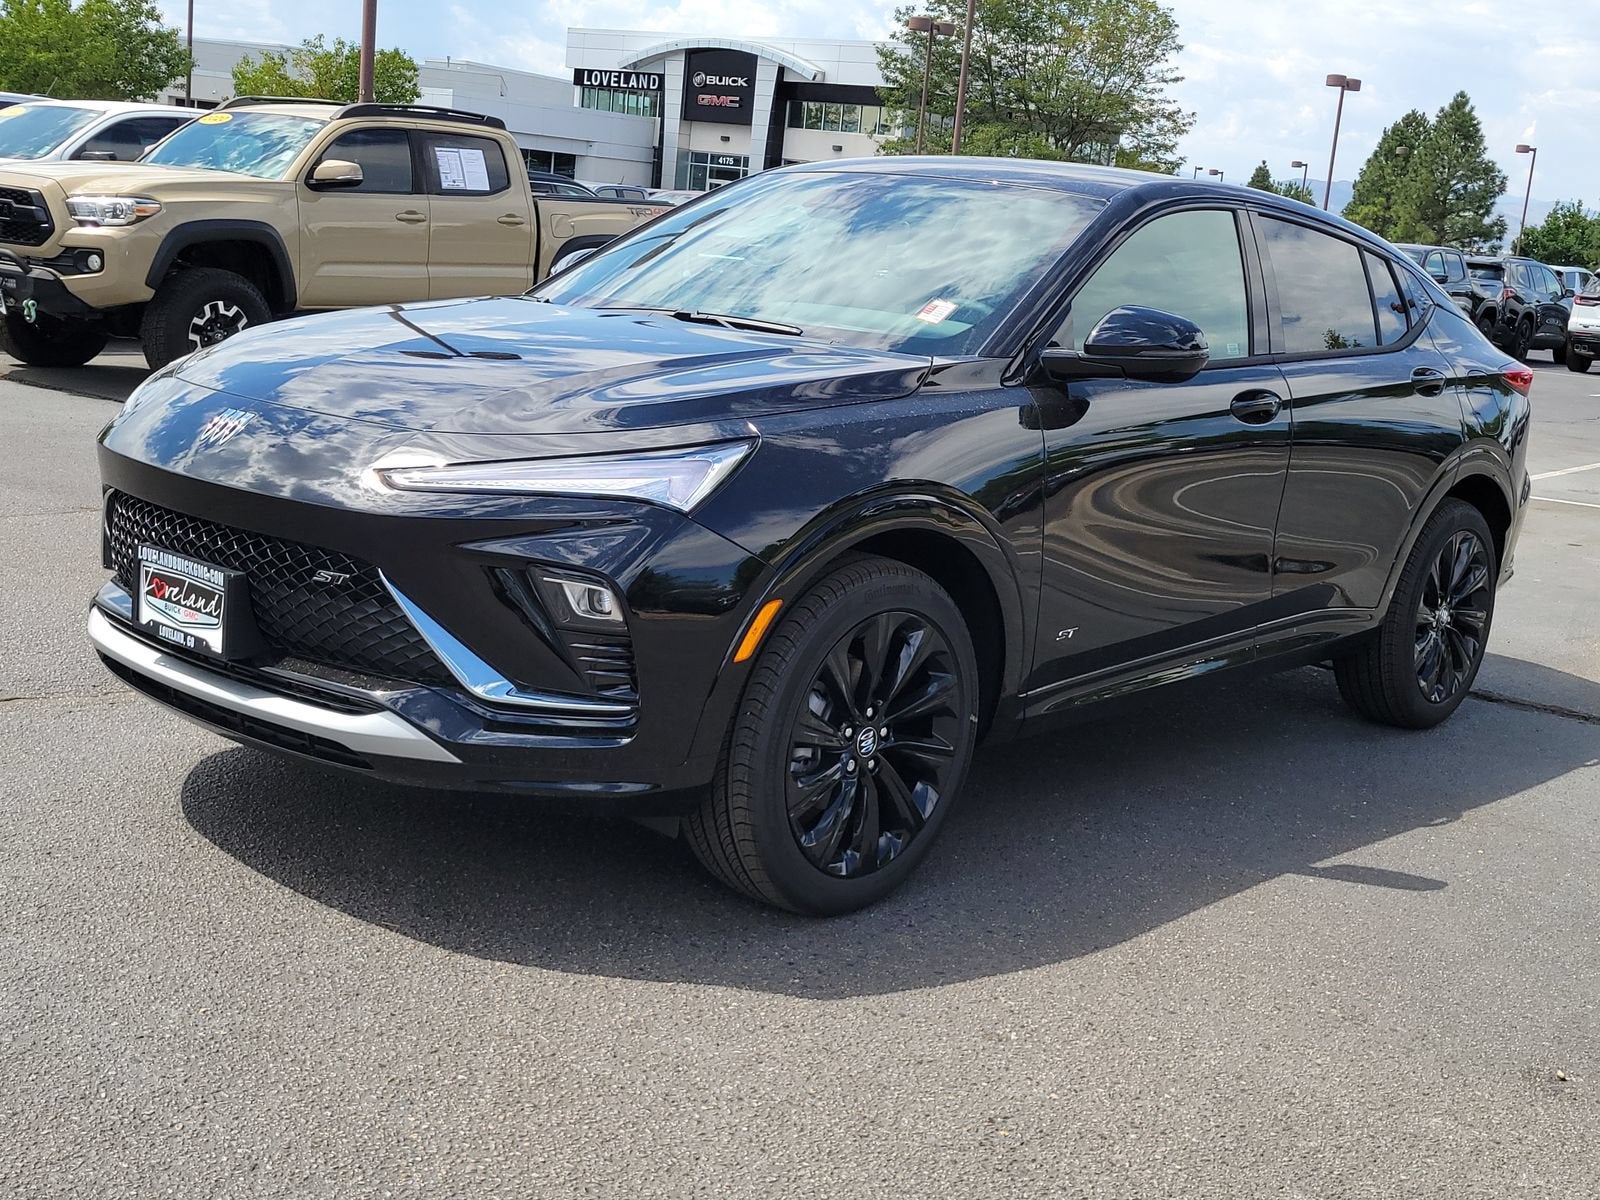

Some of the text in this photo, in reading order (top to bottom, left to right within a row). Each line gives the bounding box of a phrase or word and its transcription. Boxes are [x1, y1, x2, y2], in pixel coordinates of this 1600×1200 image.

[583, 70, 659, 90] LOVELAND
[706, 75, 748, 87] BUICK
[697, 94, 740, 108] GMC
[718, 156, 734, 165] 4175
[311, 569, 350, 585] ST
[164, 602, 199, 621] BUICK GMC
[1056, 626, 1079, 641] ST
